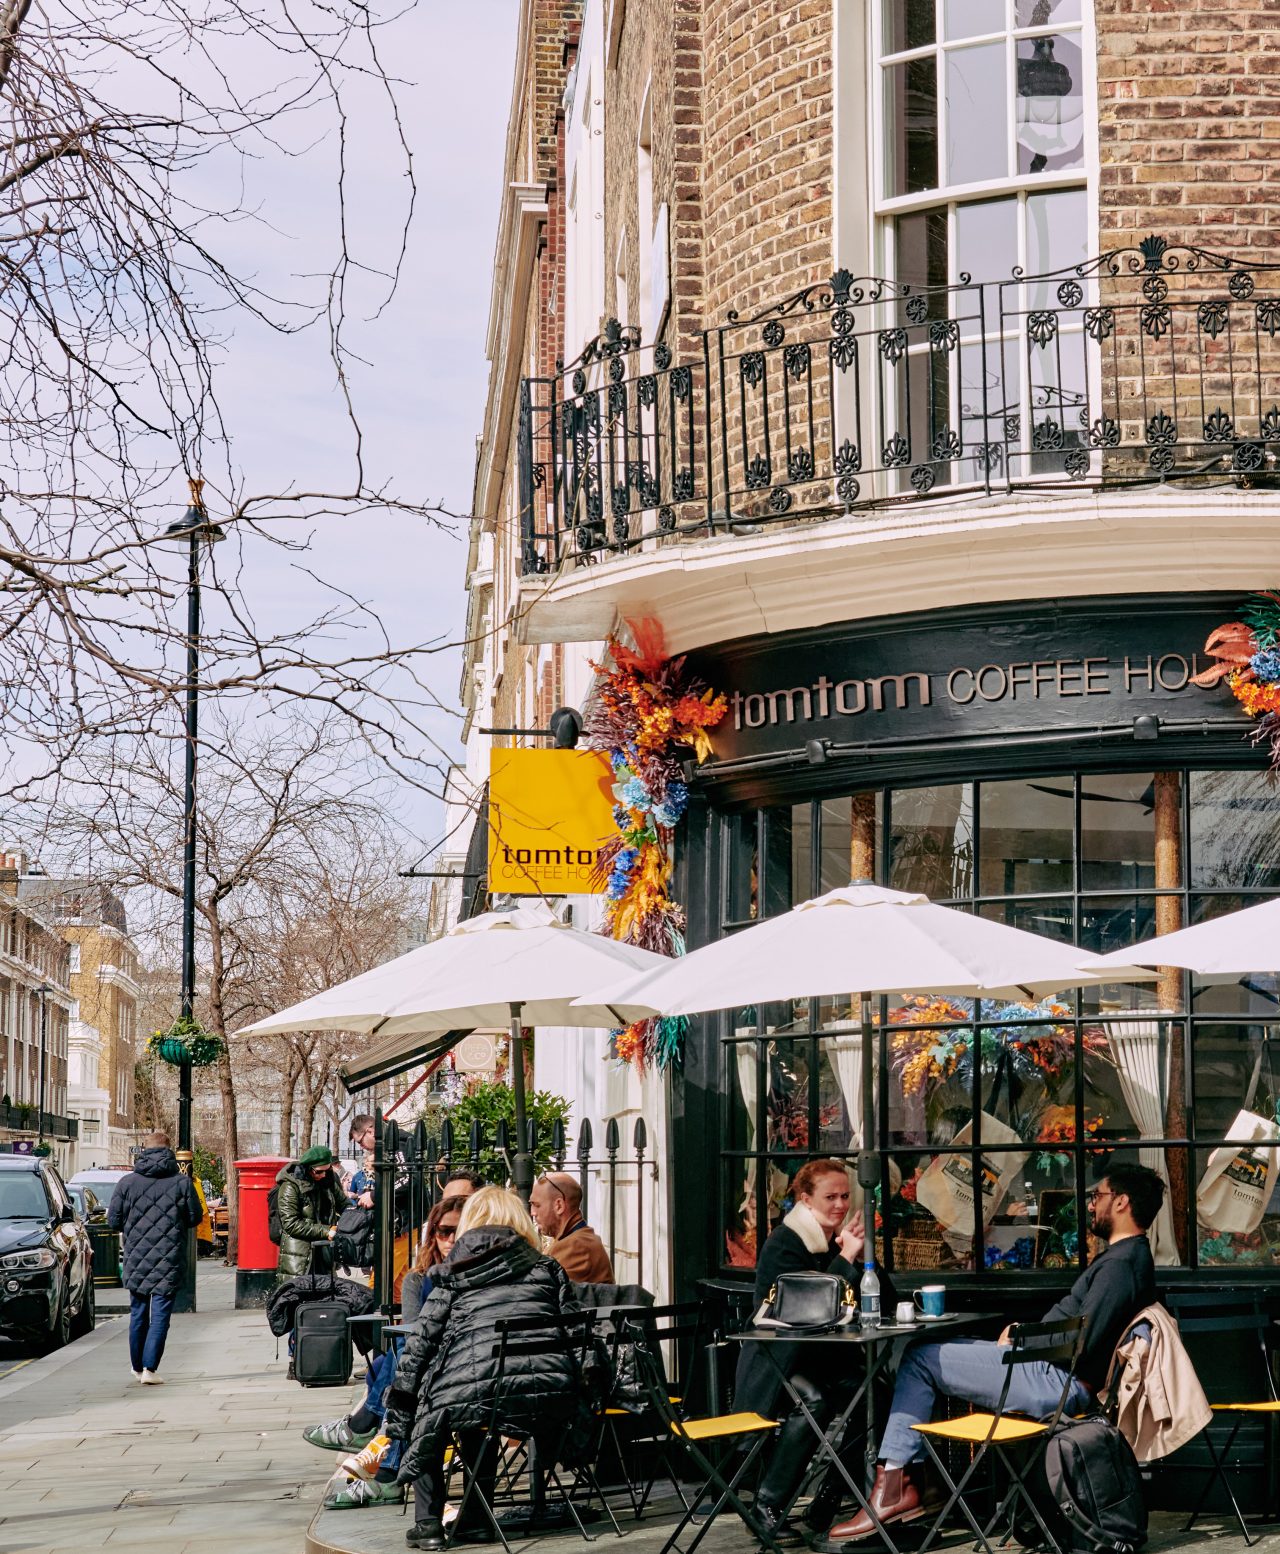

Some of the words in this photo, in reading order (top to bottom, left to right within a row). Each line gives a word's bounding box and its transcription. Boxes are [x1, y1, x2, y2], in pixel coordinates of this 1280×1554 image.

[731, 673, 930, 730] tomtom
[947, 657, 1110, 703] COFFEE
[1124, 653, 1229, 690] HOU
[502, 846, 603, 865] tomto
[502, 865, 563, 879] COFFEE
[567, 866, 592, 880] HO
